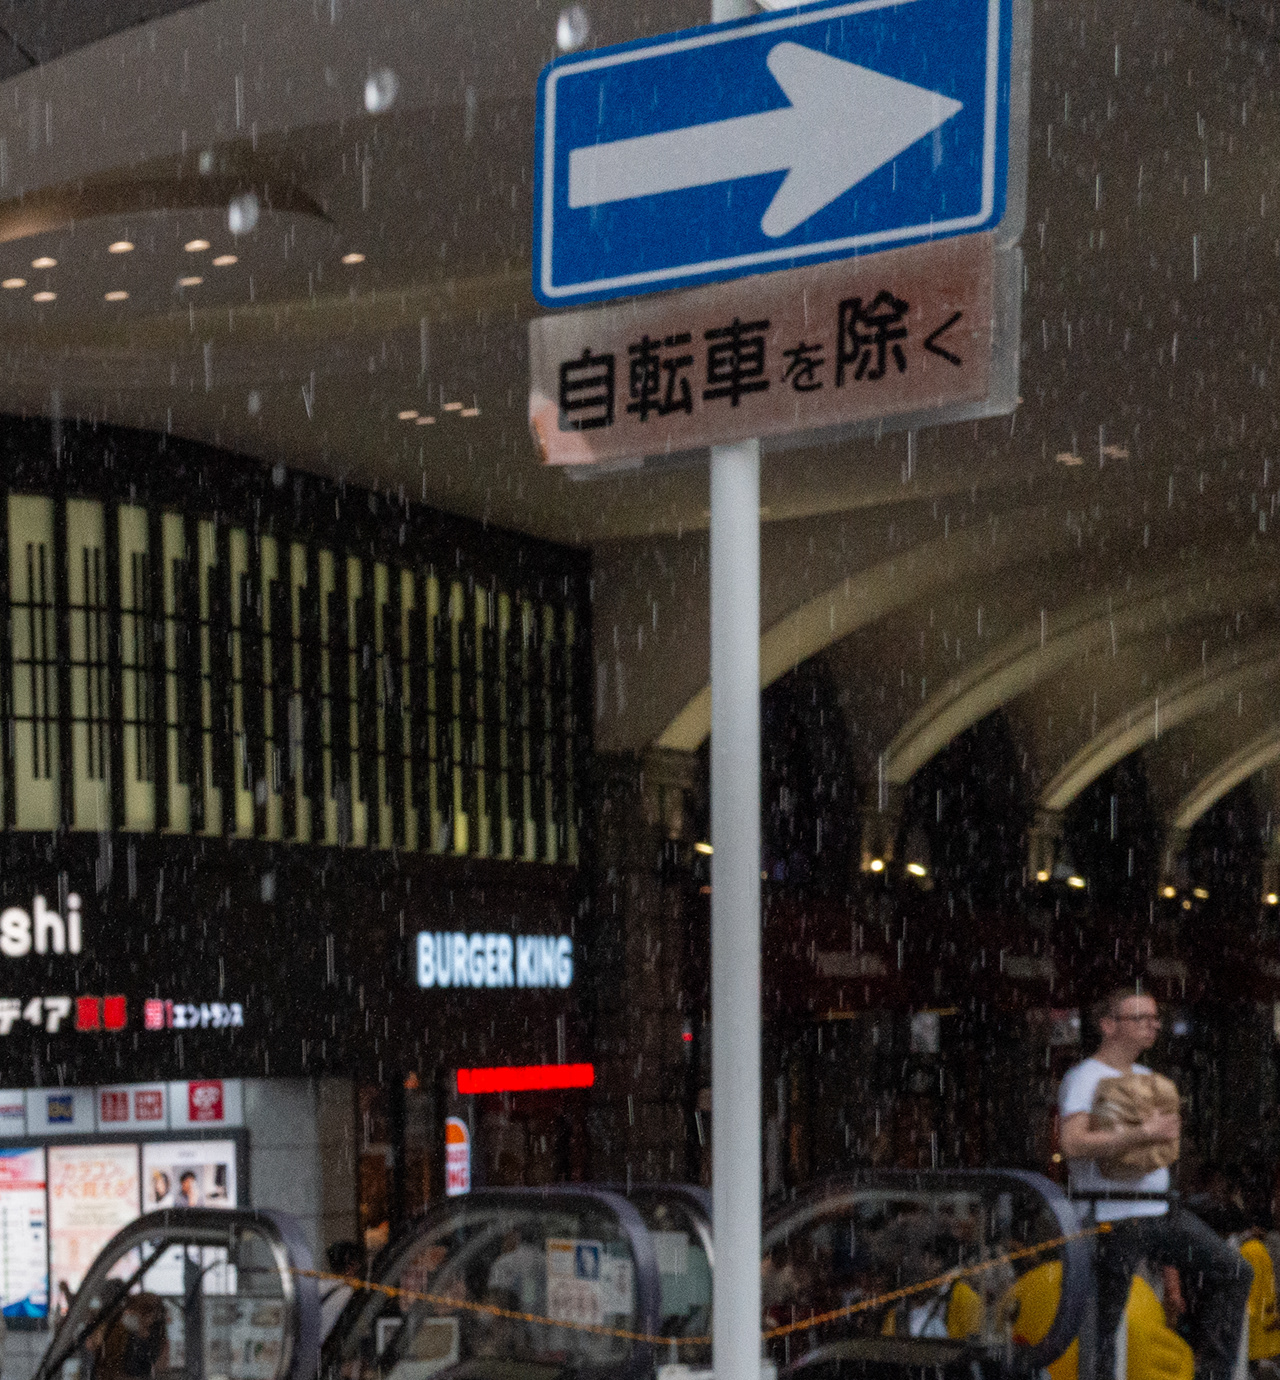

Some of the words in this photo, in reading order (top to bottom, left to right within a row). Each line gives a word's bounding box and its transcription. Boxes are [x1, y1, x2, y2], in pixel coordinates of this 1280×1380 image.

[557, 291, 963, 431] 自転車を除く
[417, 931, 515, 989] BURGER
[516, 934, 574, 989] KING
